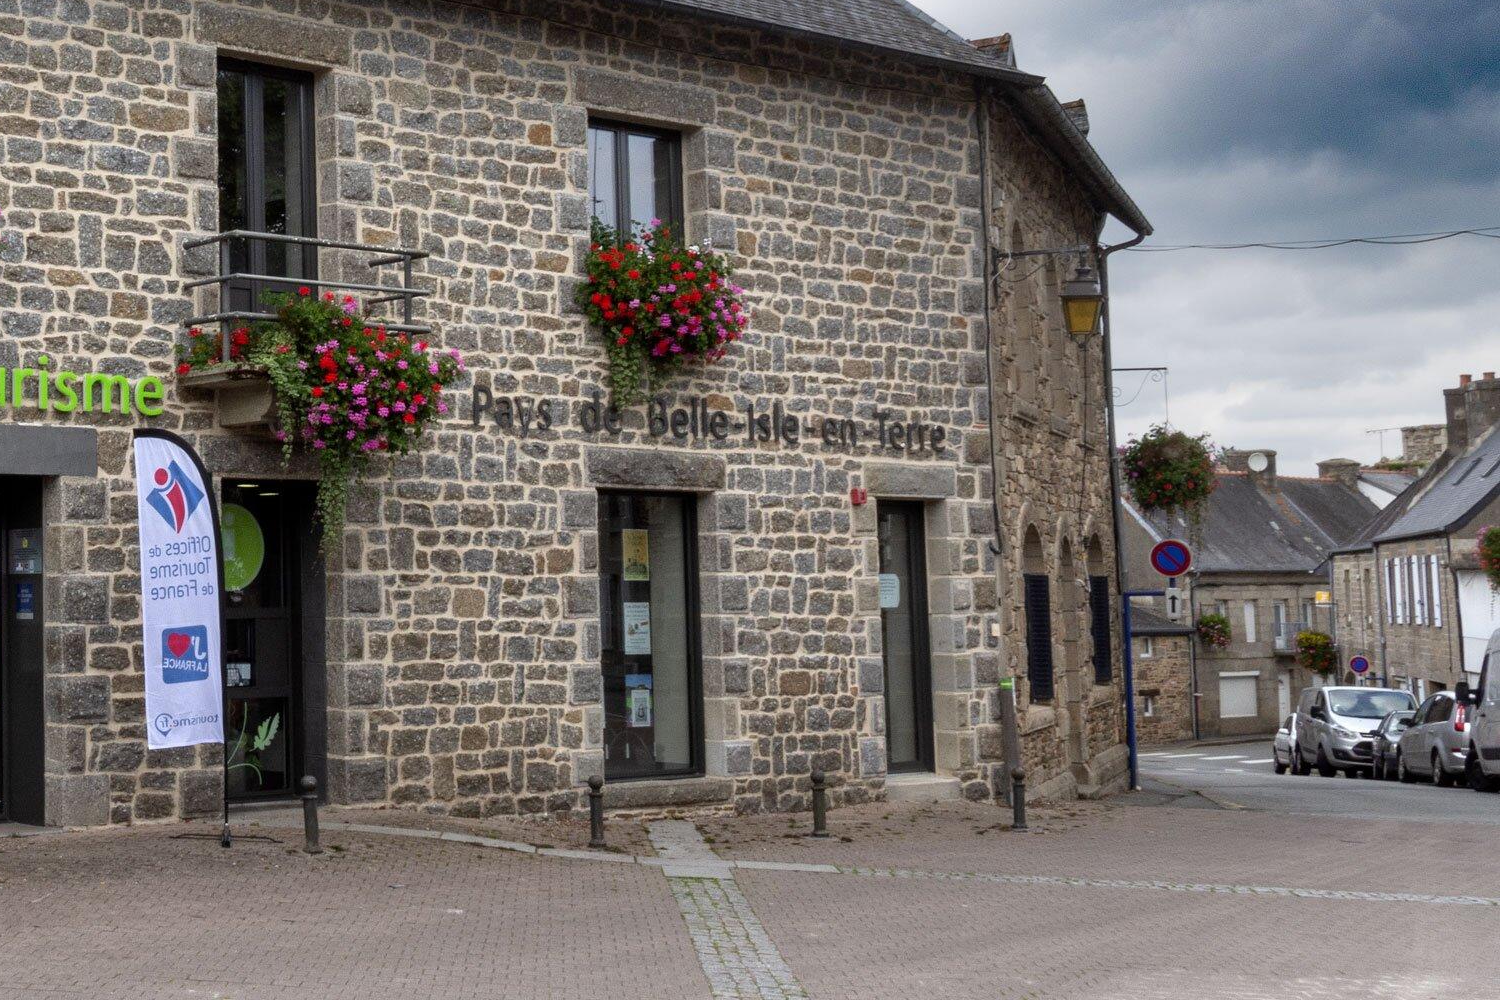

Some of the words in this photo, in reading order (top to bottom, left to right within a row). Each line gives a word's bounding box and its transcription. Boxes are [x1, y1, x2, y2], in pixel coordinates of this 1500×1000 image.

[472, 384, 553, 439] Pays
[580, 390, 623, 435] de
[647, 396, 947, 453] Belle-Isle-en-Terre
